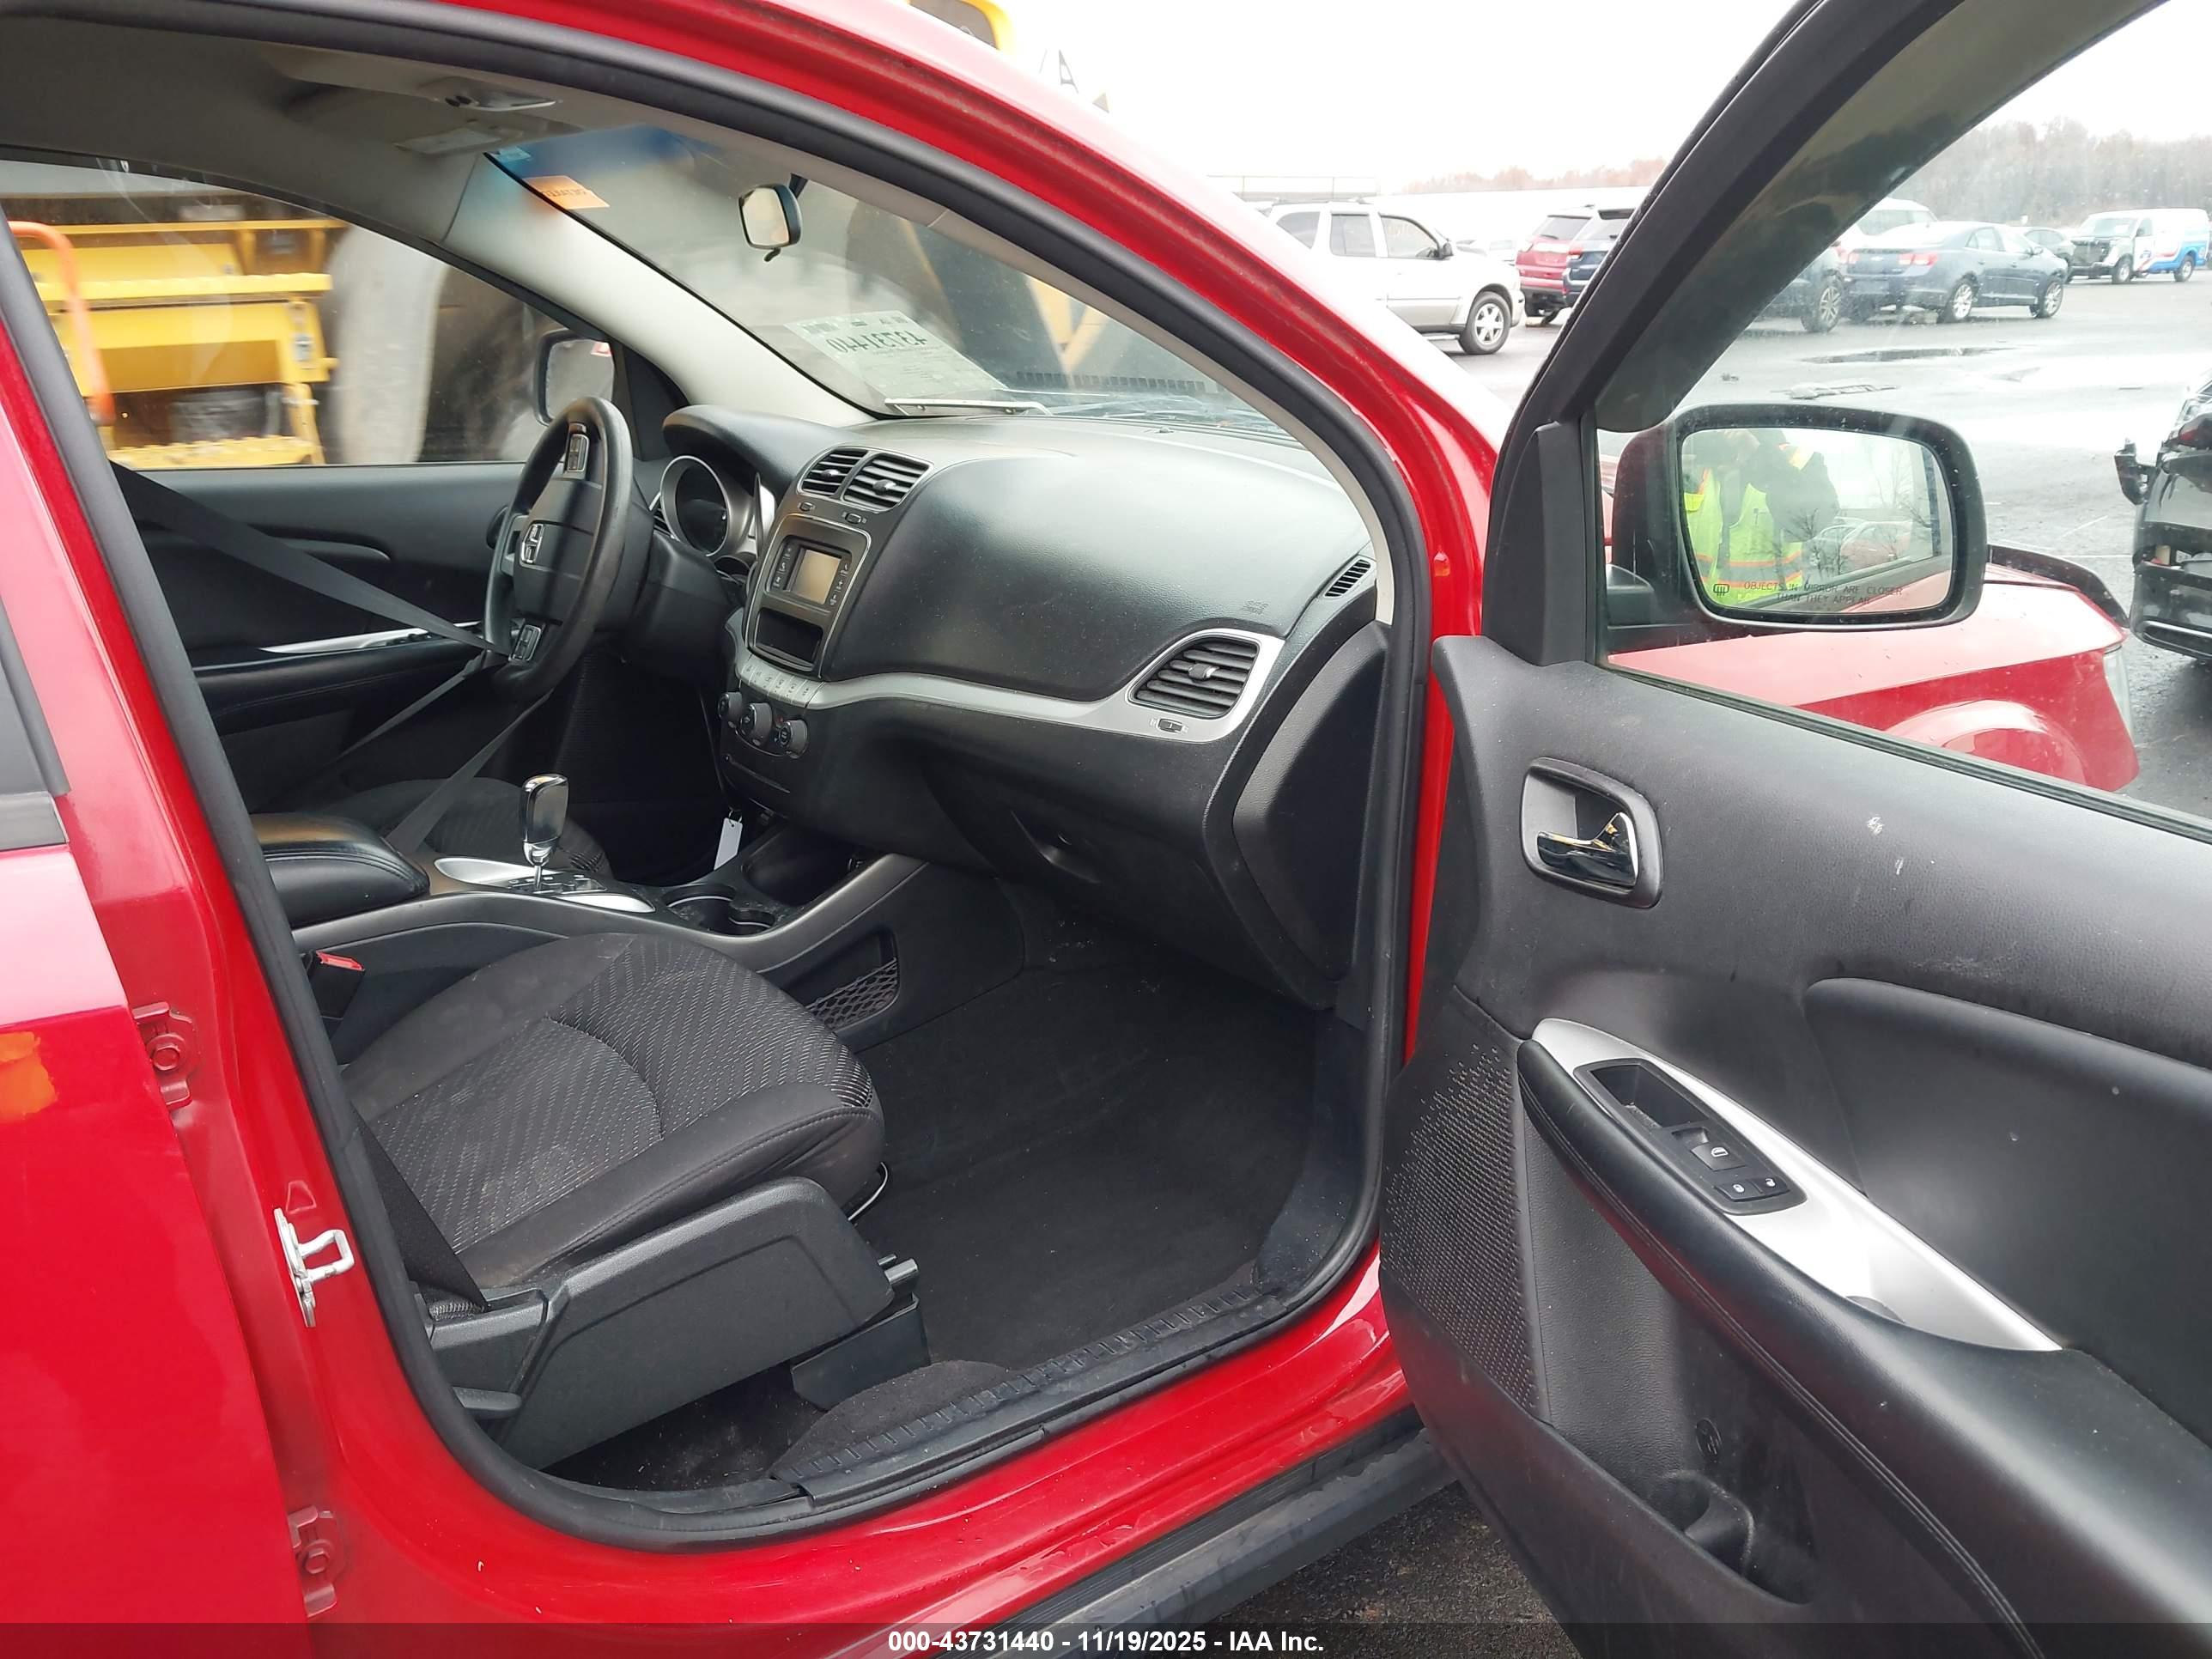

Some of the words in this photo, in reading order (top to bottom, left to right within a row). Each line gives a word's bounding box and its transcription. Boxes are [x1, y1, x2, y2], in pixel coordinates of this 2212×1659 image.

[1744, 581, 1785, 591] OBJECTS
[1804, 583, 1838, 592] MIRROR
[1867, 586, 1903, 595] CLOSER
[1778, 592, 1801, 601] THAN
[1806, 594, 1829, 603] THEY
[1833, 595, 1870, 605] APPEAR
